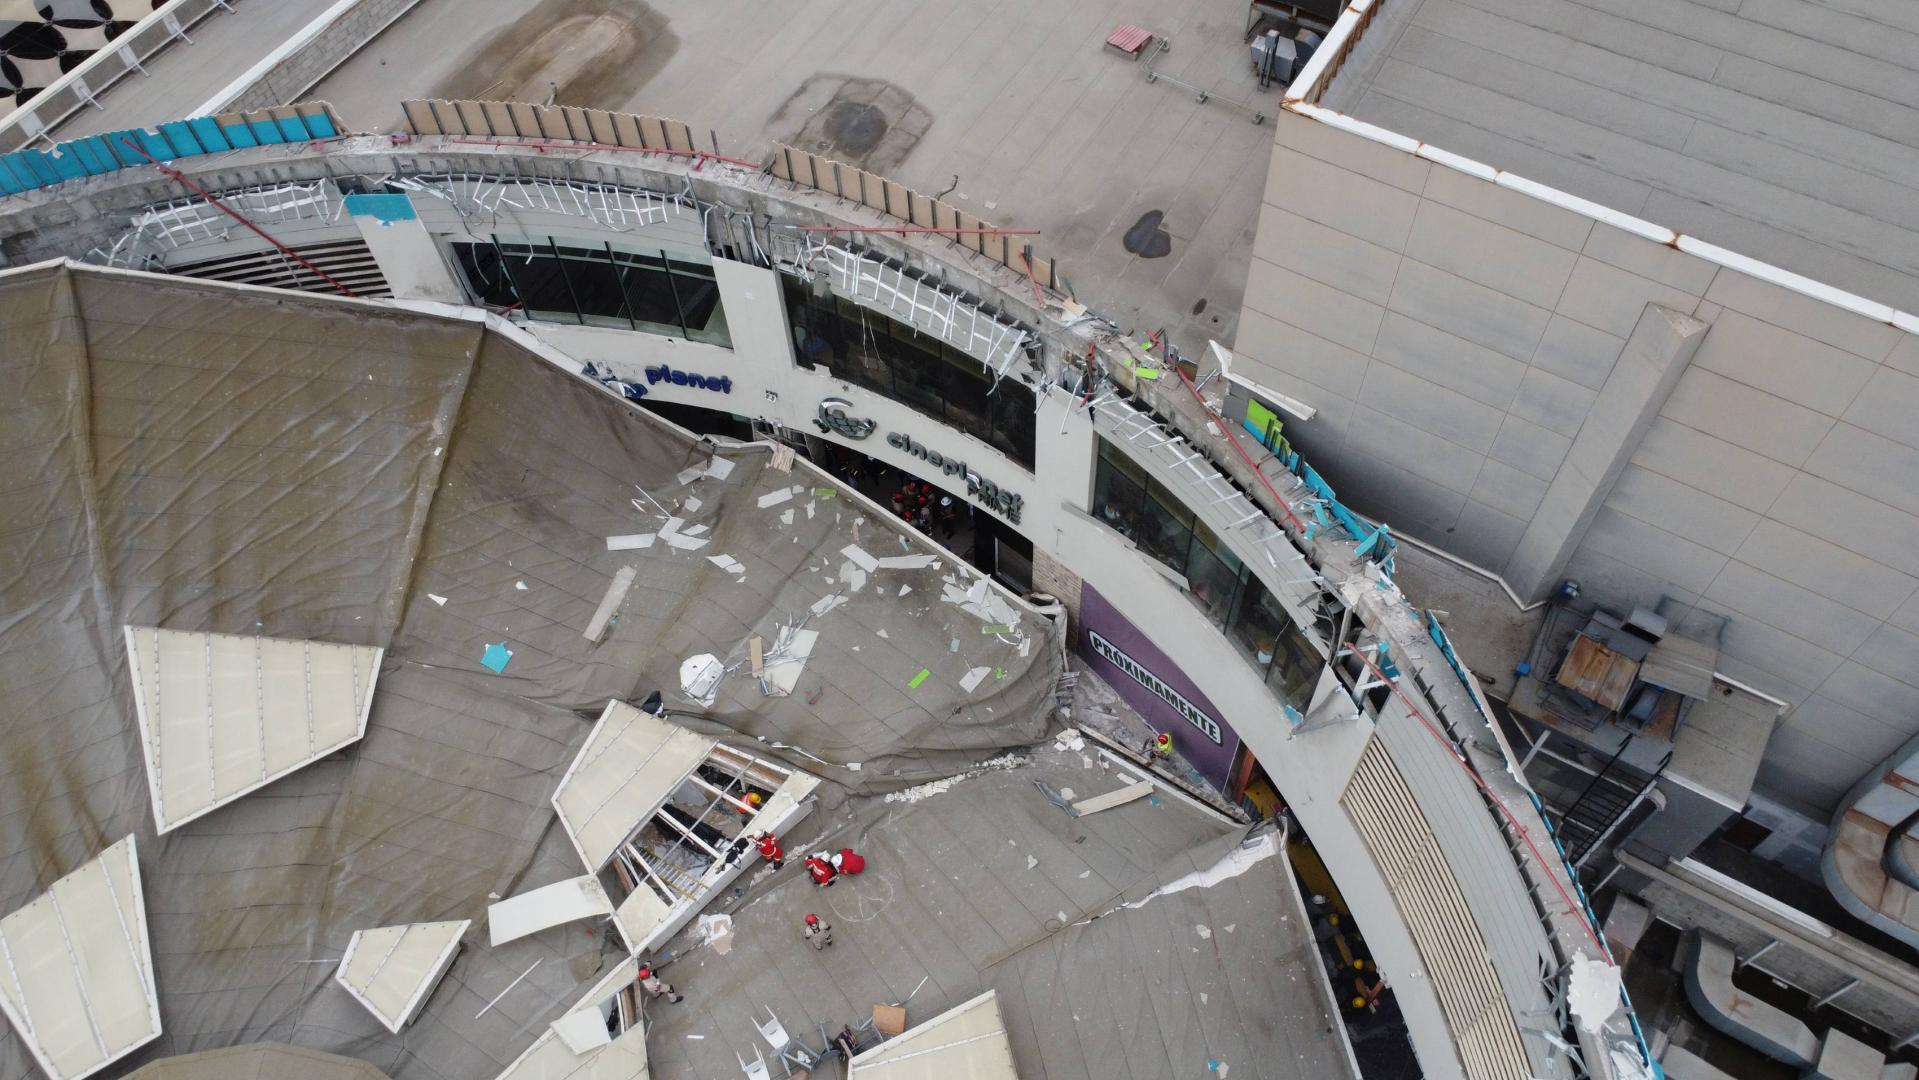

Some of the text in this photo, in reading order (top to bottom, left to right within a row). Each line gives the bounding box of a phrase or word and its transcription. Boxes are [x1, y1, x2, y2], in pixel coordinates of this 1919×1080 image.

[645, 364, 733, 395] planet
[887, 431, 1024, 513] cineplanet
[1092, 635, 1219, 741] PRÓXIMAMENTE
